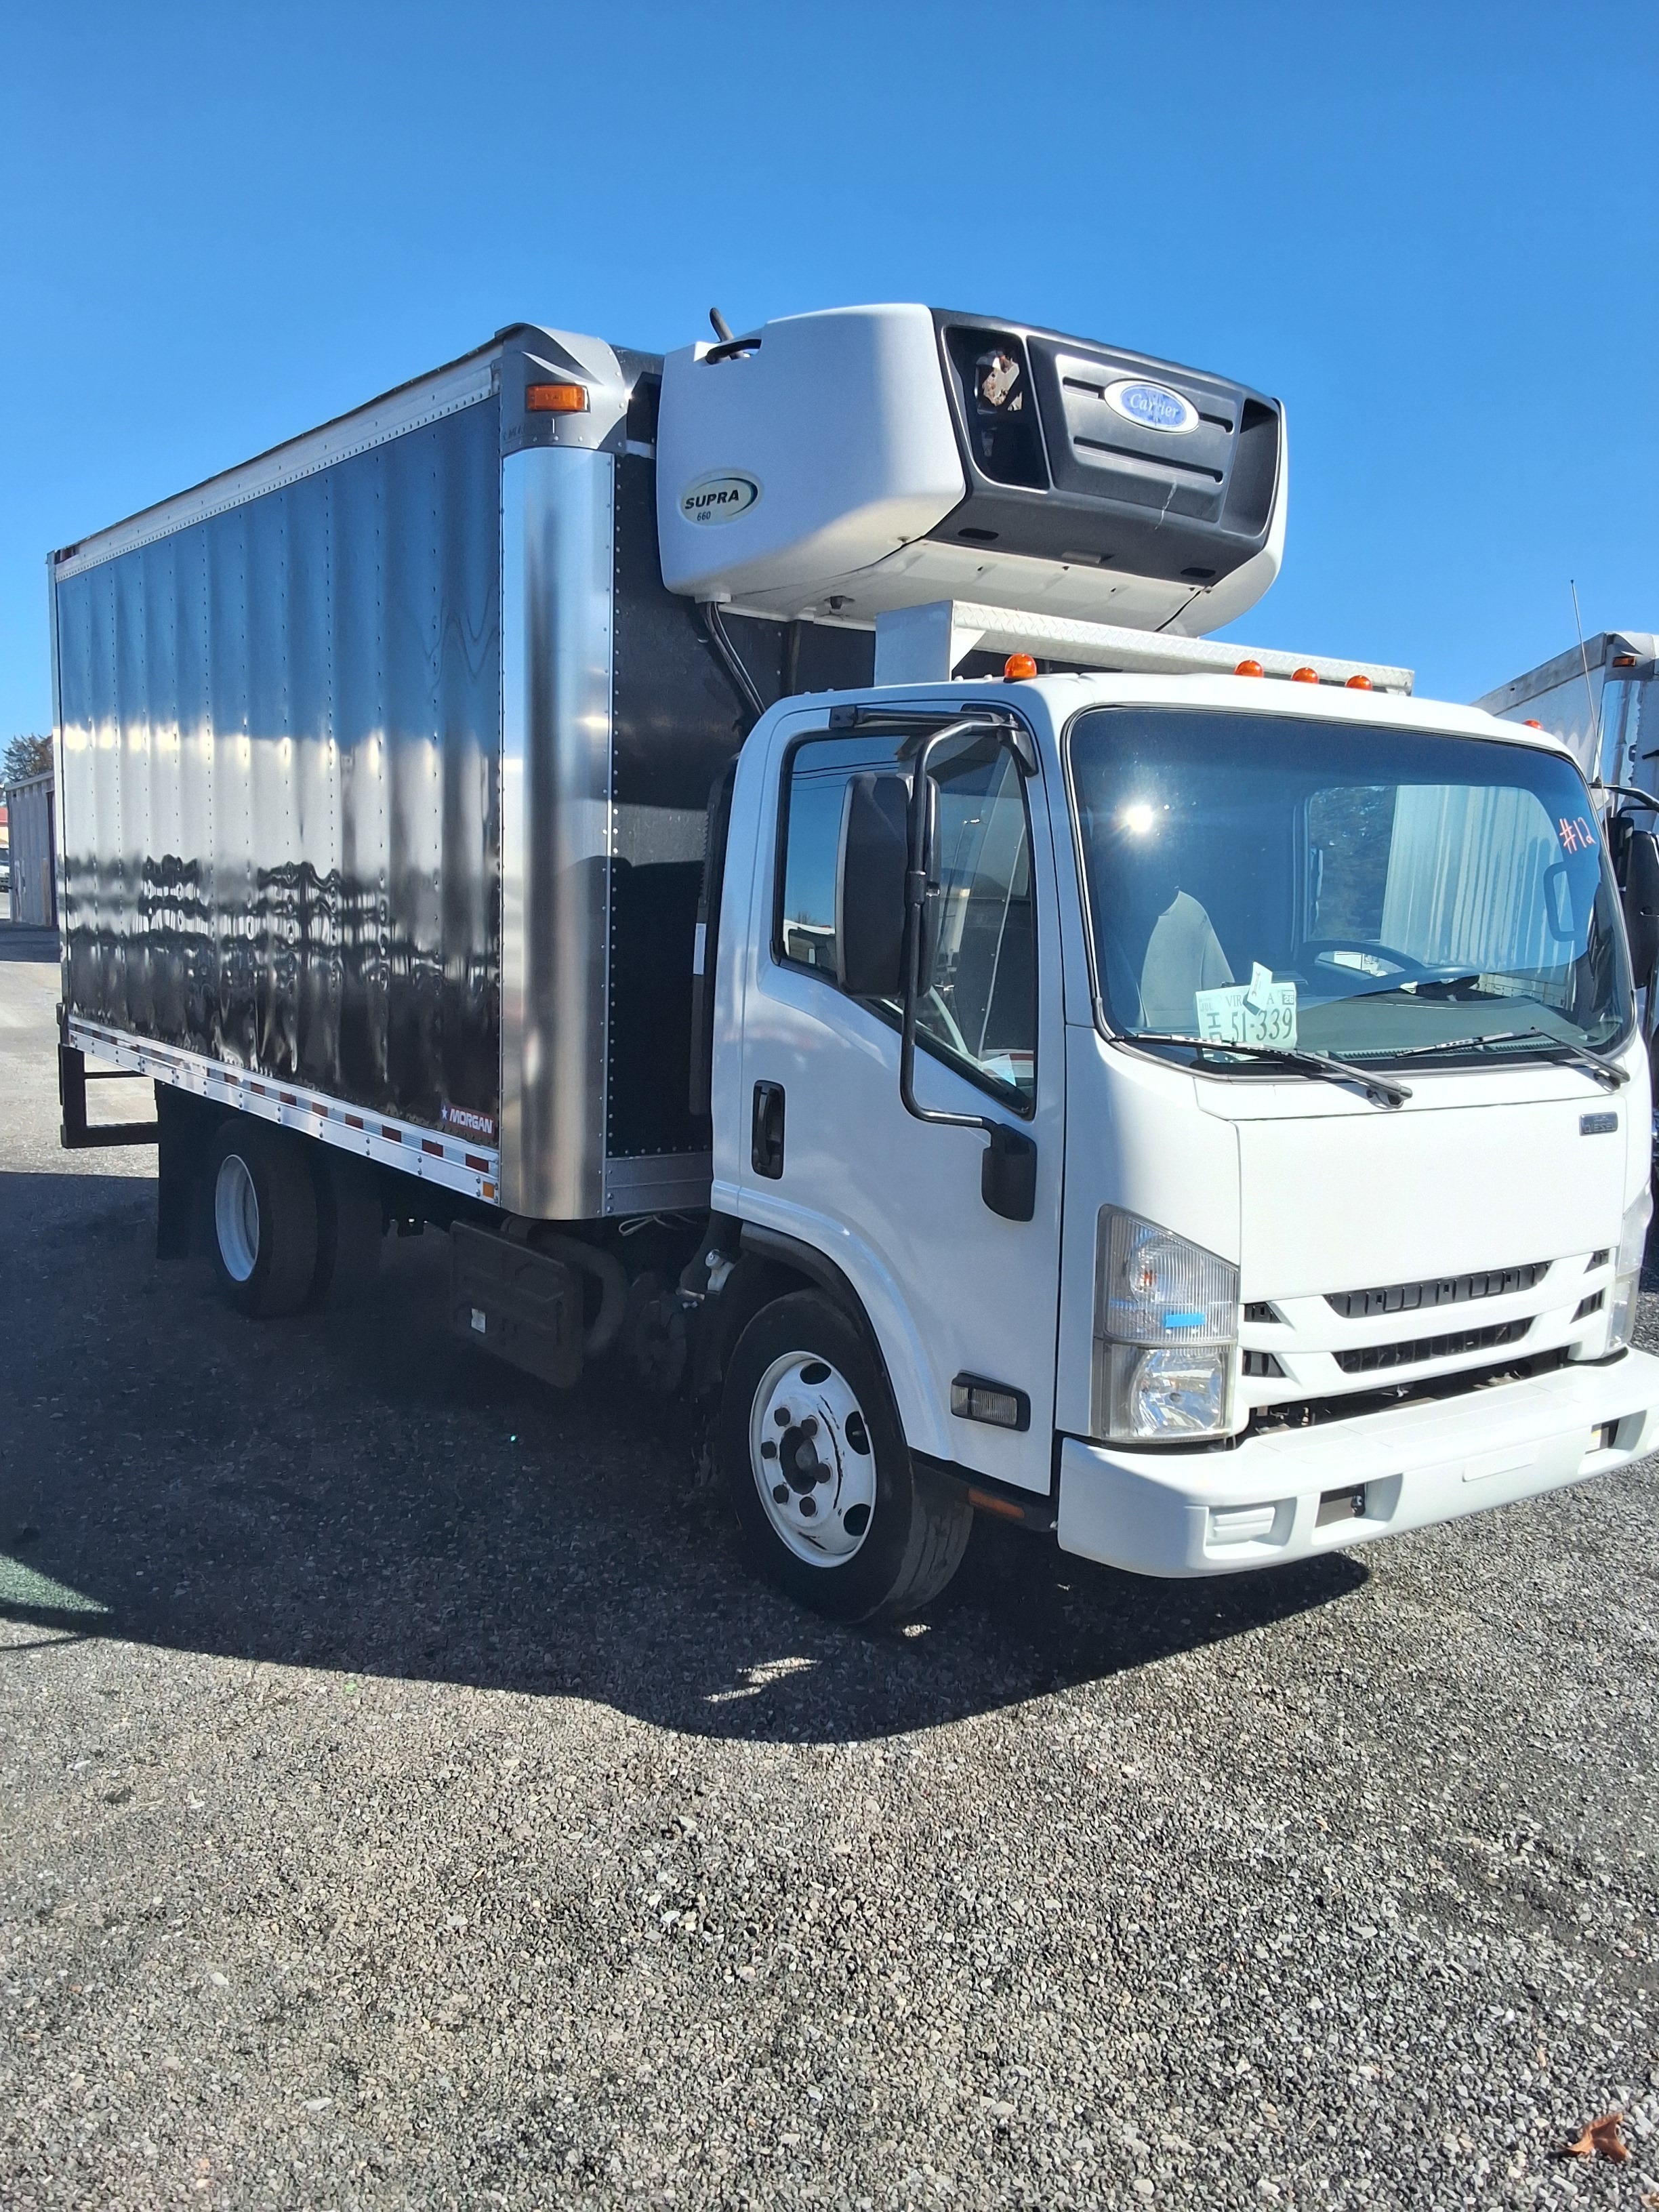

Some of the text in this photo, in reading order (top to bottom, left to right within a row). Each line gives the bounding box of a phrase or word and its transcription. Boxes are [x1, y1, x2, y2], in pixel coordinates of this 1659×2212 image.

[1130, 393, 1179, 418] Carrier
[684, 489, 739, 510] SUPRA
[697, 511, 711, 521] 660
[1559, 817, 1597, 855] #12
[1200, 1002, 1212, 1012] JUL
[1225, 994, 1275, 1007] VIRA
[1284, 995, 1294, 1004] 26
[1231, 1008, 1292, 1042] 51-339
[449, 1108, 493, 1134] MORGAN
[1584, 1122, 1616, 1132] DIESEL
